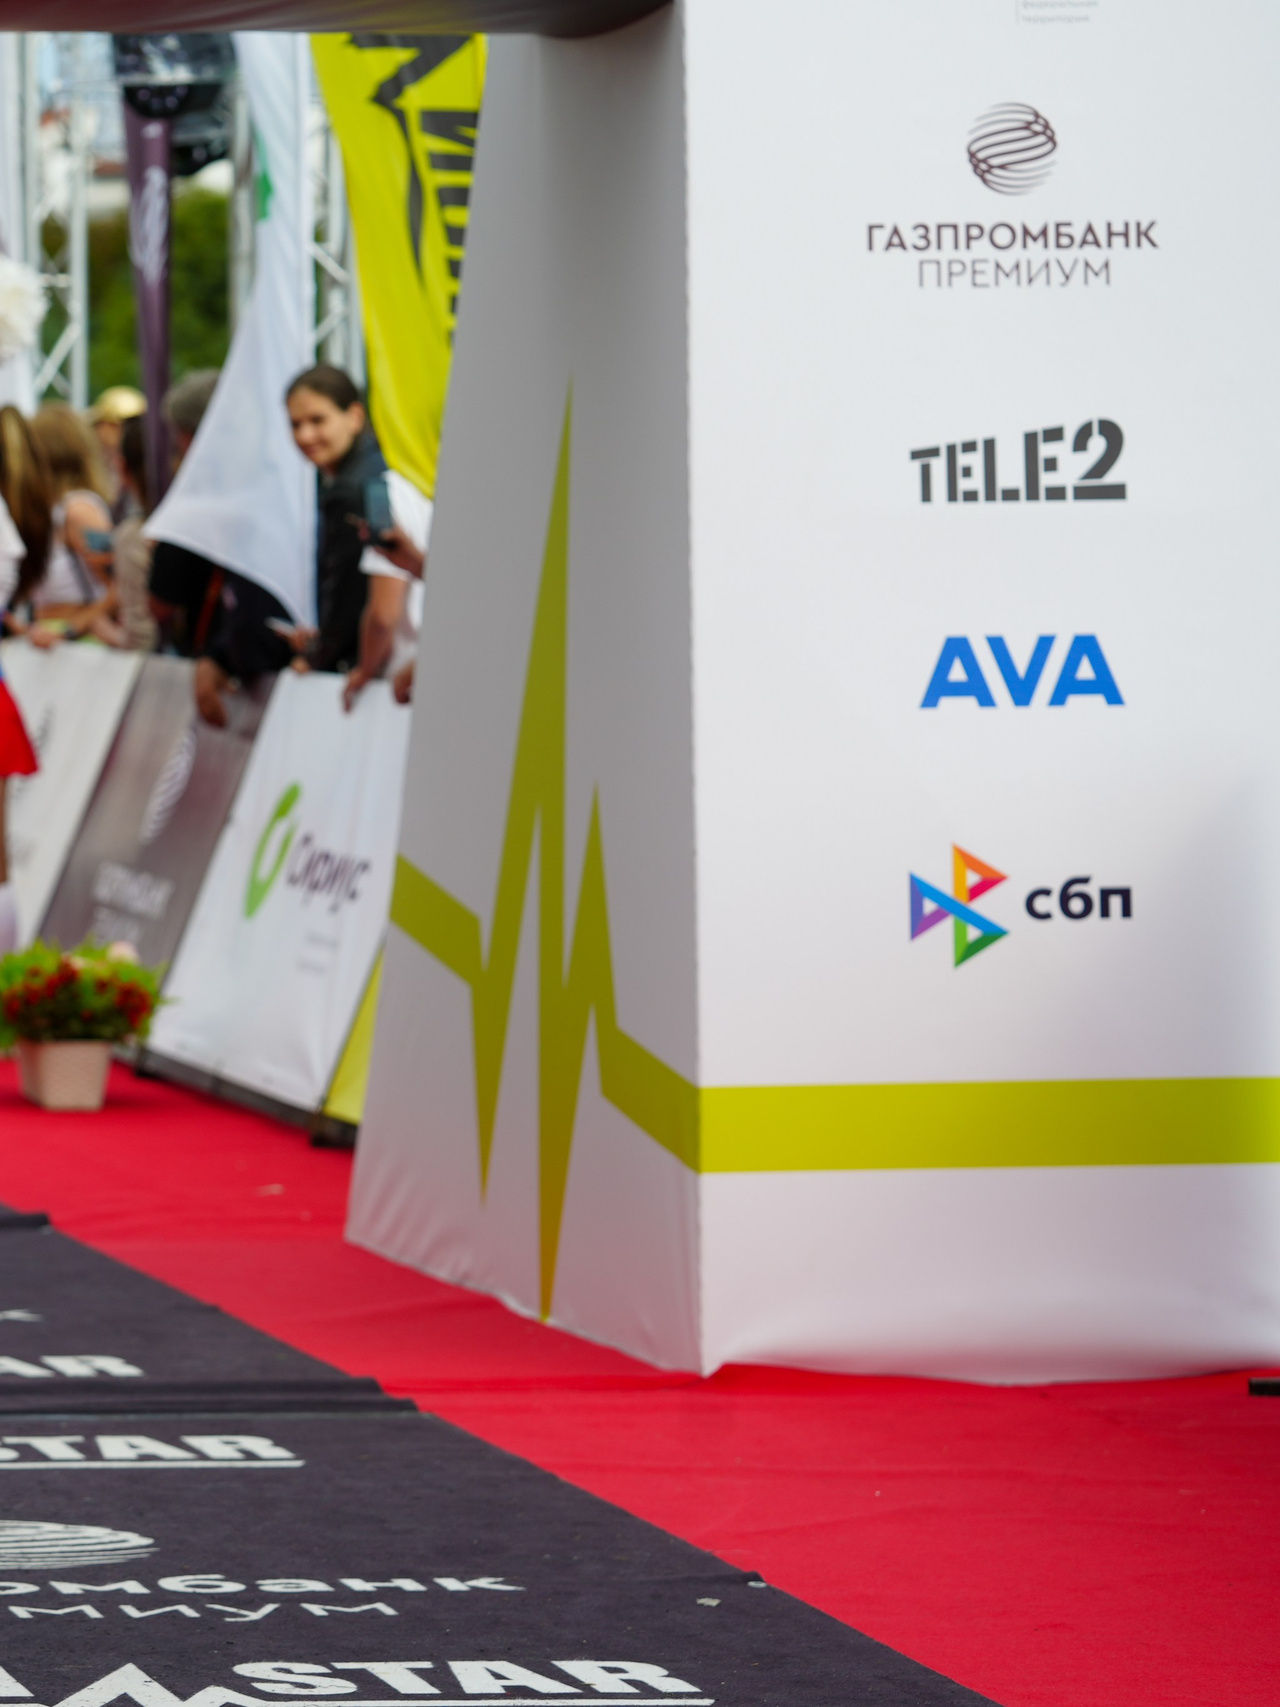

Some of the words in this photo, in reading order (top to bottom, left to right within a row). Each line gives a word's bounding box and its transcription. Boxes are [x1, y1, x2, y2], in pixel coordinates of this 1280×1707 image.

[867, 220, 1159, 252] ГАЗПРОМБАНК
[917, 256, 1111, 288] ПРЕМИУМ
[910, 418, 1127, 502] TELE2
[919, 633, 1126, 709] AVA
[1024, 875, 1133, 920] сбп
[231, 1659, 704, 1697] STAR
